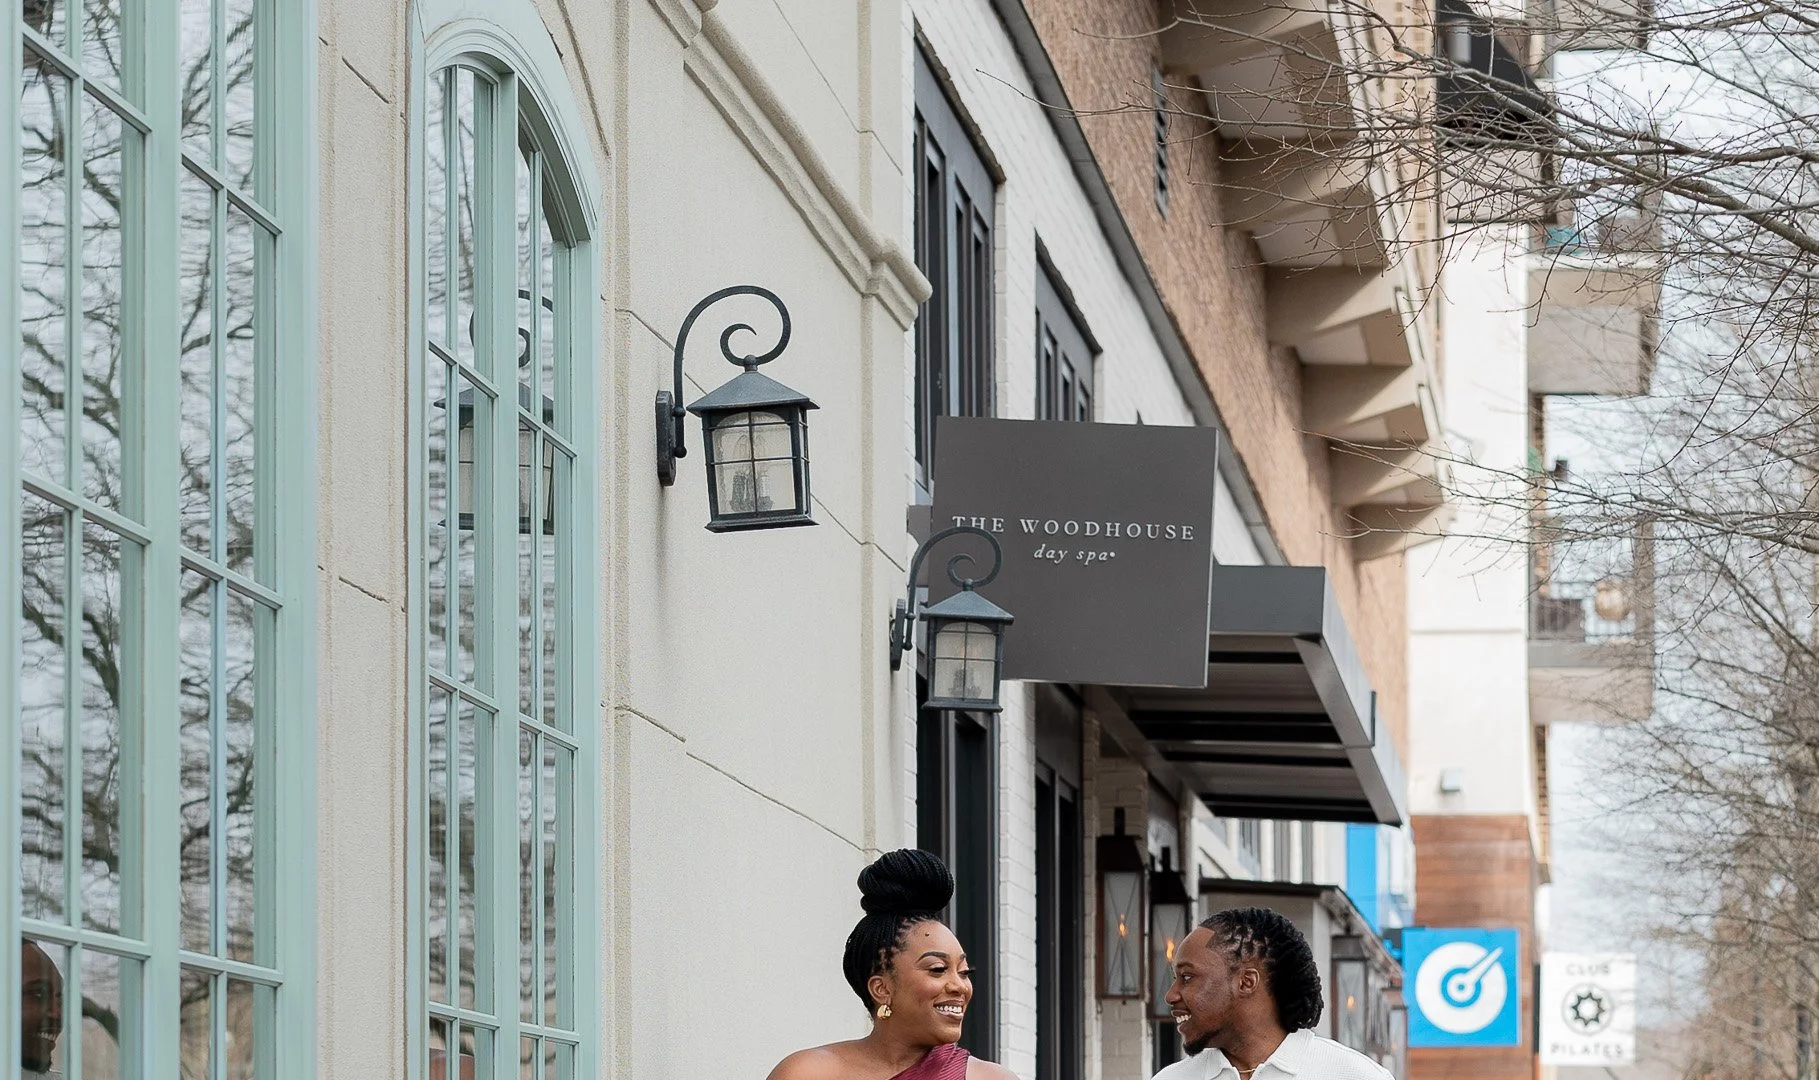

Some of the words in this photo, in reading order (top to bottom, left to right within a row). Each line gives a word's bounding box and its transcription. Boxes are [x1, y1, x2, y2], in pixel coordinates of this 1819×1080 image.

[952, 515, 1005, 533] THE
[1019, 517, 1195, 541] WOODHOUSE
[1033, 543, 1069, 564] day
[1566, 963, 1611, 977] CLUB
[1550, 1042, 1624, 1059] PILATES
